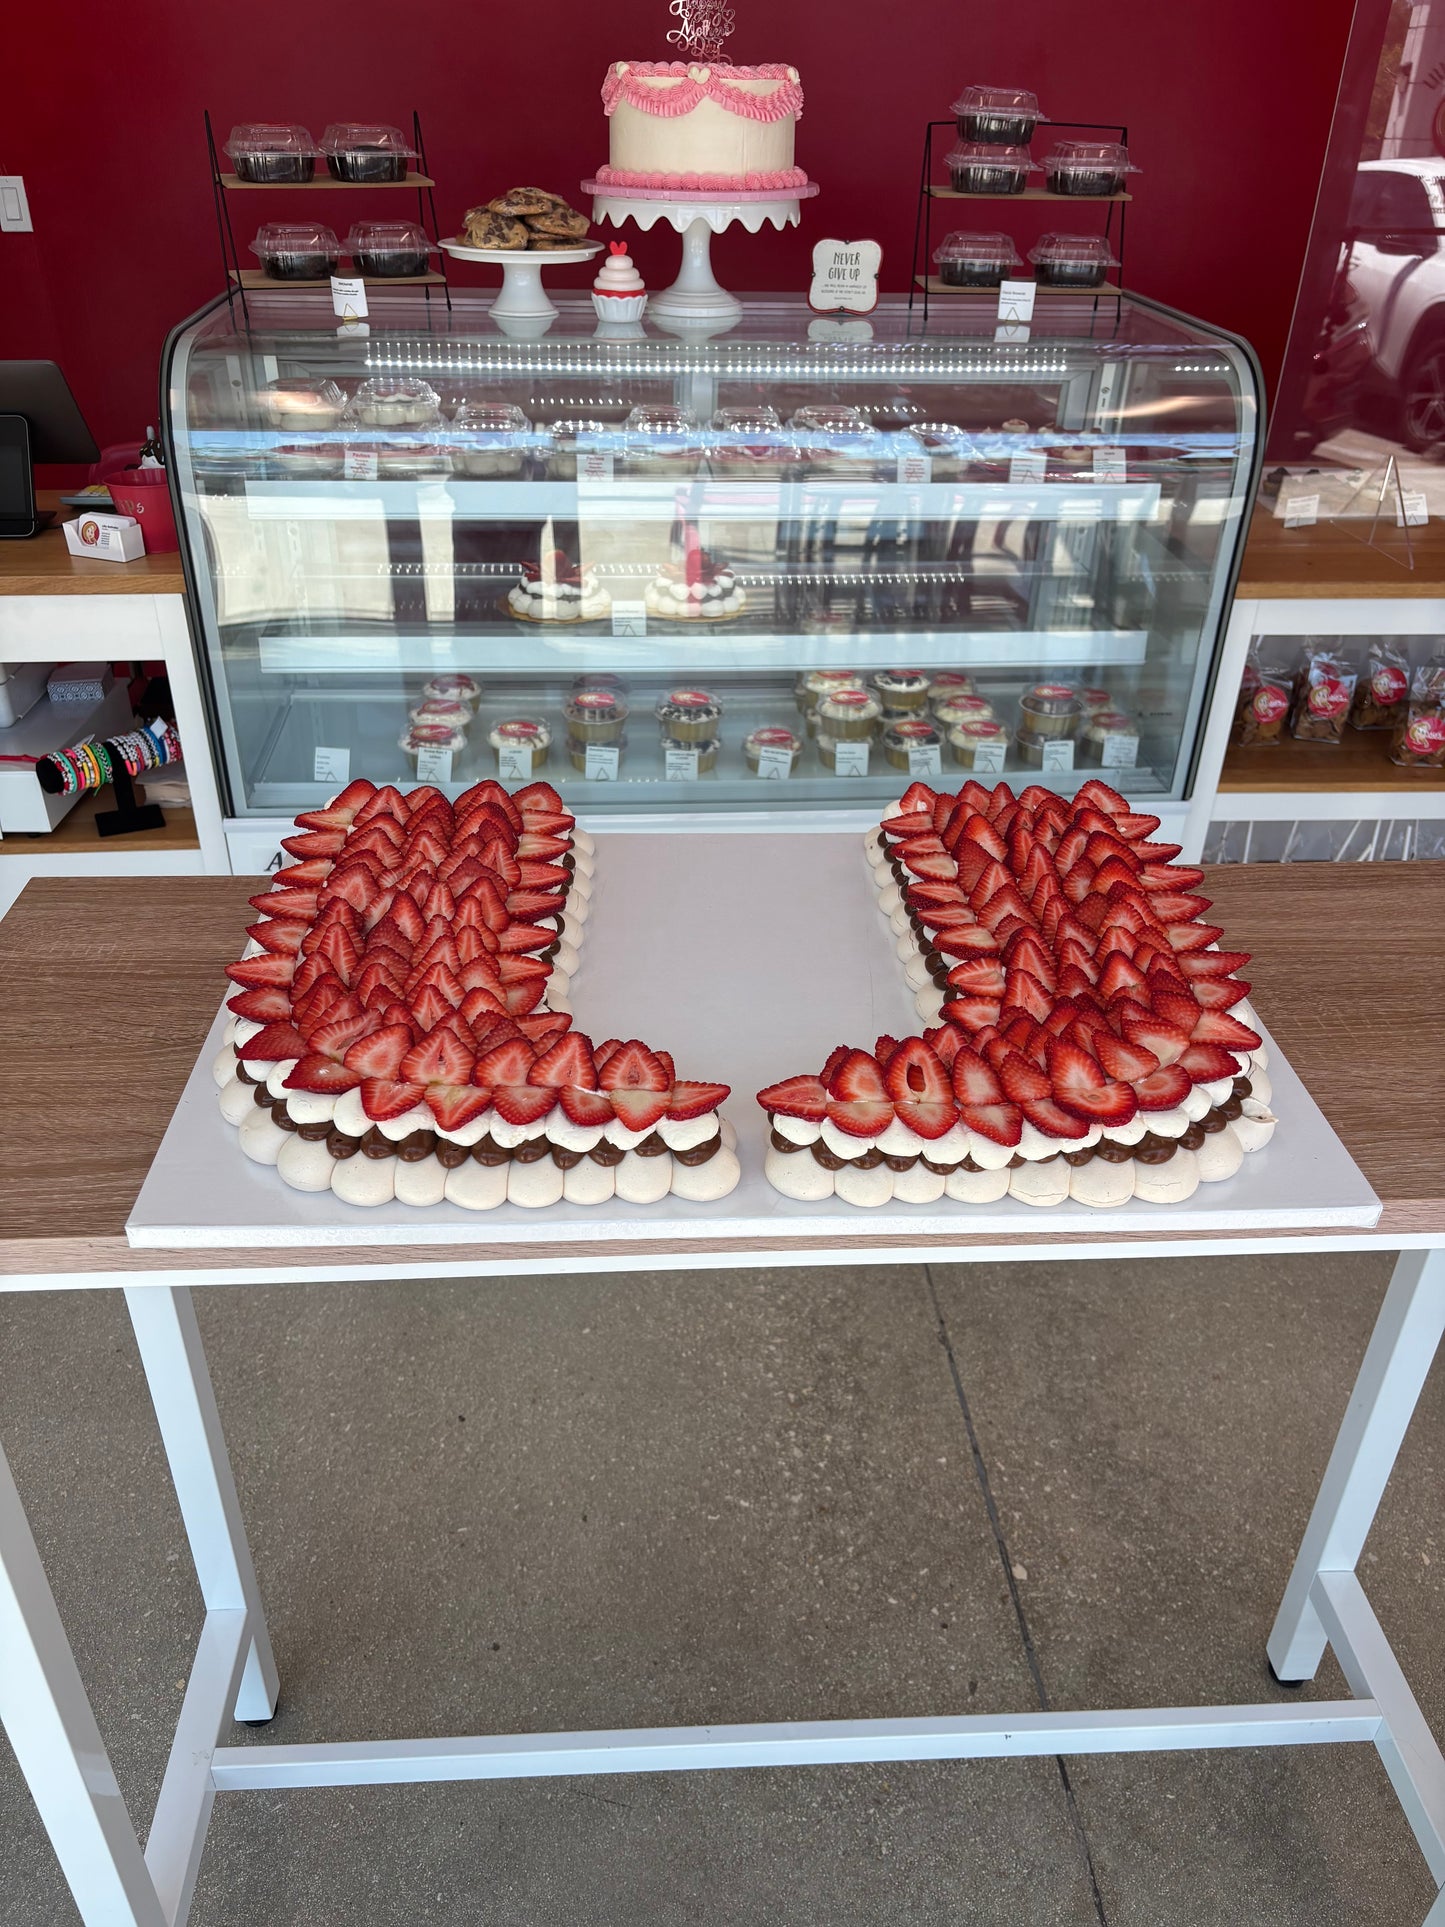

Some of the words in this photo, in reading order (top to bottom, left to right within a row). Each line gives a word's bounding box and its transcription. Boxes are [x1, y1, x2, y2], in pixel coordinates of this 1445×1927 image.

[833, 252, 861, 266] NEVER
[828, 267, 848, 281] GIVE
[849, 268, 861, 281] UP
